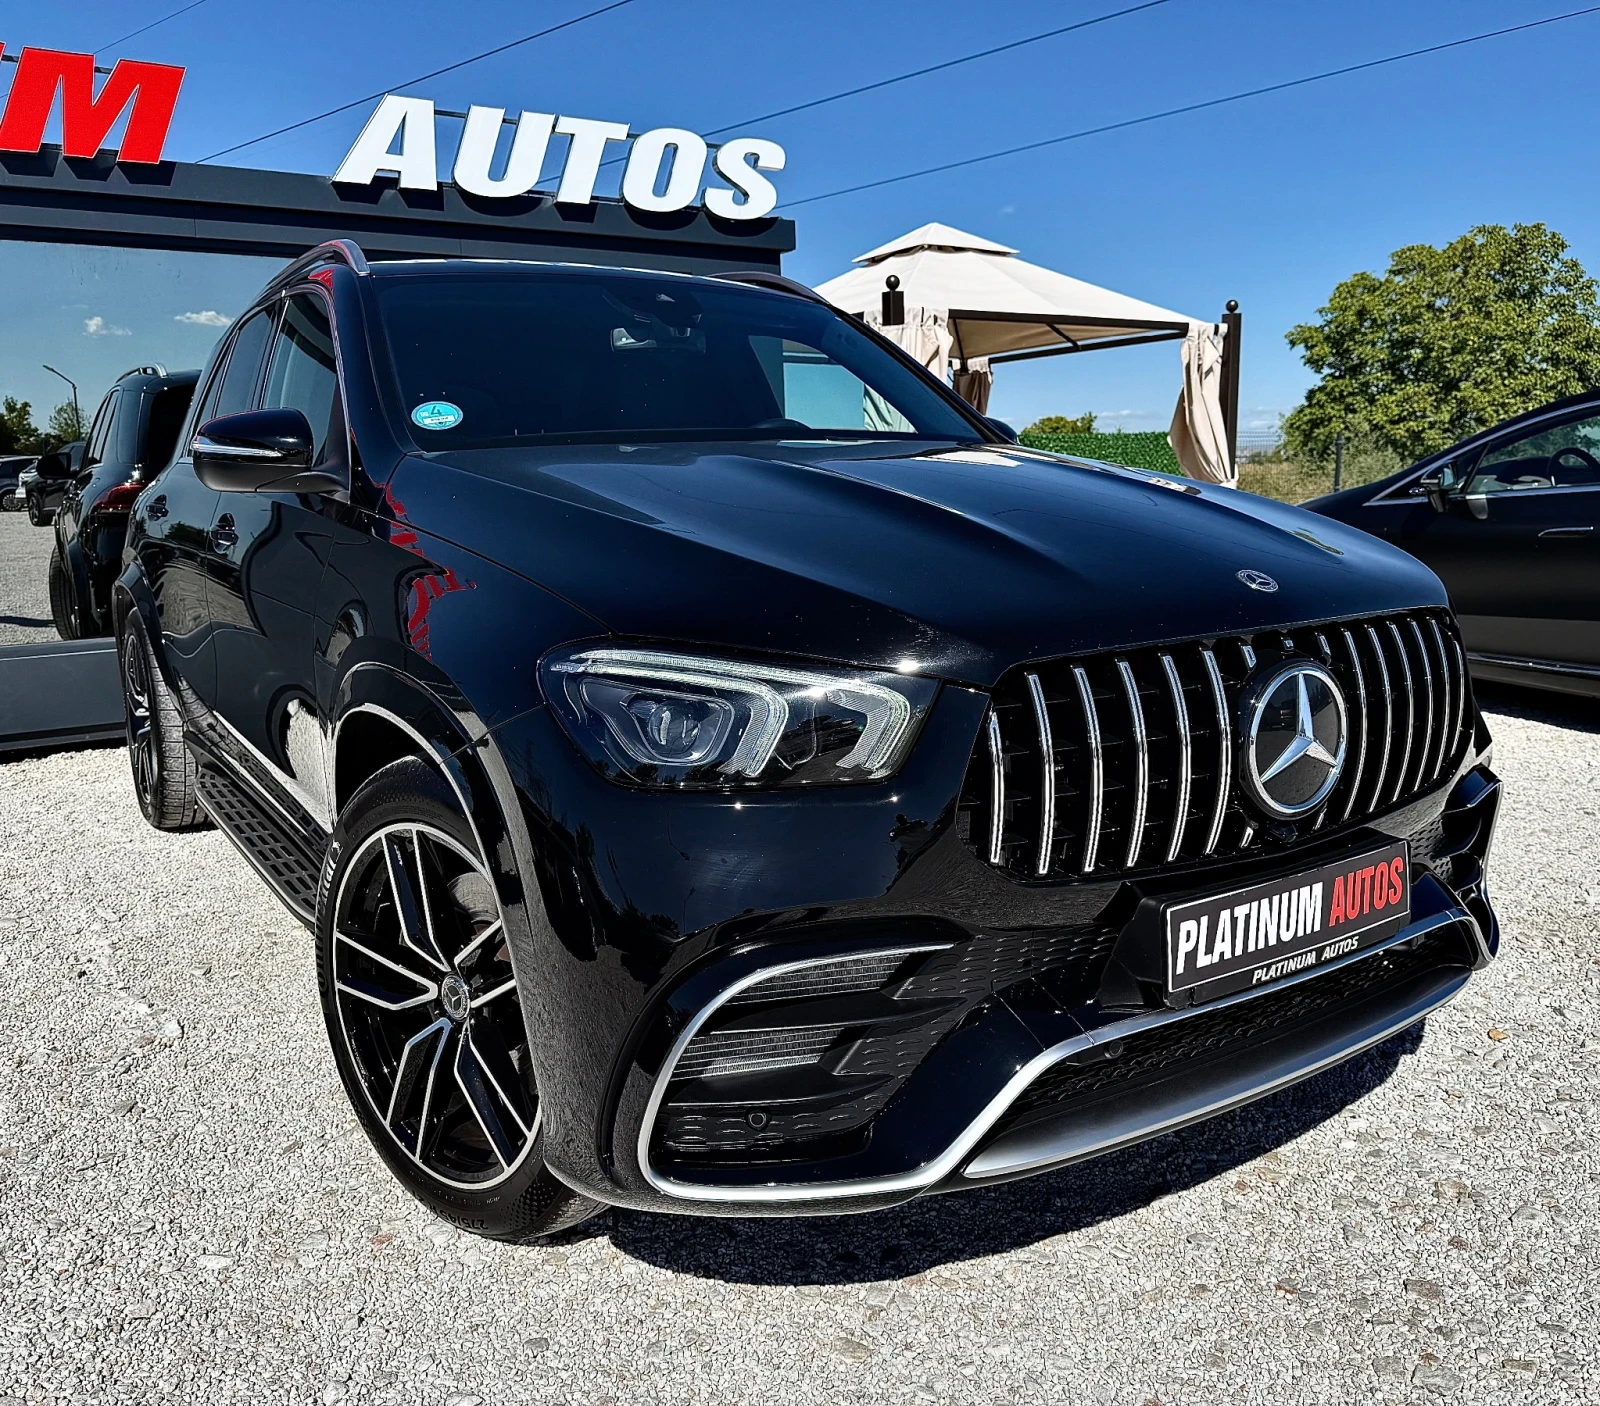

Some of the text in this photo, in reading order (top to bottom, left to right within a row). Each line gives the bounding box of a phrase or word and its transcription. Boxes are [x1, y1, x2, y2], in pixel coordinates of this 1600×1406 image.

[0, 41, 187, 164] M
[331, 93, 787, 221] AUTOS
[1175, 856, 1404, 975] PLATINUM AUTOS
[1251, 935, 1360, 985] PLATINUM AUTOS
